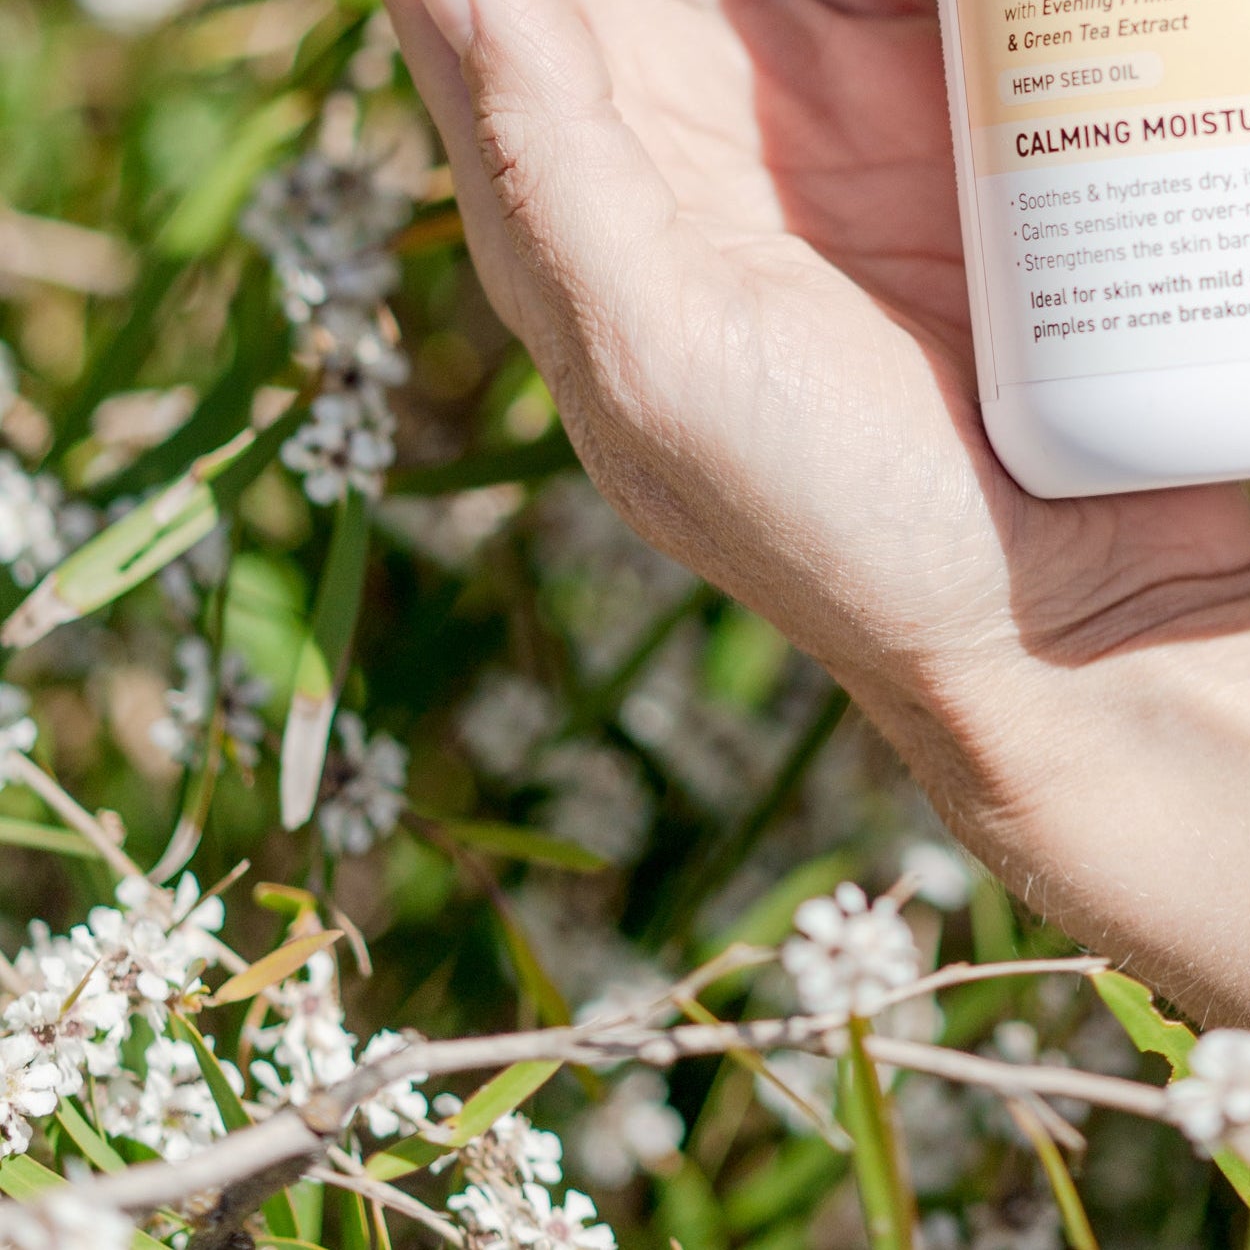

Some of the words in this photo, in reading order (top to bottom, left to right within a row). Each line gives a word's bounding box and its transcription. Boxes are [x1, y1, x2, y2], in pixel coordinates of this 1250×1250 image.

[1005, 2, 1036, 22] with
[1008, 34, 1018, 51] &
[1024, 30, 1072, 49] Green
[1080, 24, 1110, 41] Tea
[1119, 15, 1190, 37] Extract
[1013, 75, 1055, 95] HEMP
[1060, 69, 1102, 88] SEED
[1109, 64, 1139, 82] OIL
[1016, 121, 1130, 157] CALMING
[1019, 188, 1081, 211] Soothes
[1087, 184, 1100, 202] &
[1107, 177, 1192, 203] hydrates
[1198, 172, 1237, 193] dry,
[1021, 221, 1069, 241] Calms
[1075, 209, 1158, 235] sensitive
[1164, 209, 1184, 225] or
[1025, 246, 1127, 271] Strengthens
[1133, 238, 1163, 259] the
[1170, 234, 1212, 256] skin
[1031, 288, 1067, 309] Ideal
[1073, 286, 1097, 303] for
[1104, 281, 1142, 301] skin
[1150, 275, 1192, 295] with
[1200, 269, 1243, 291] mild
[1034, 316, 1095, 342] pimples
[1102, 315, 1120, 330] or
[1128, 310, 1171, 328] acne
